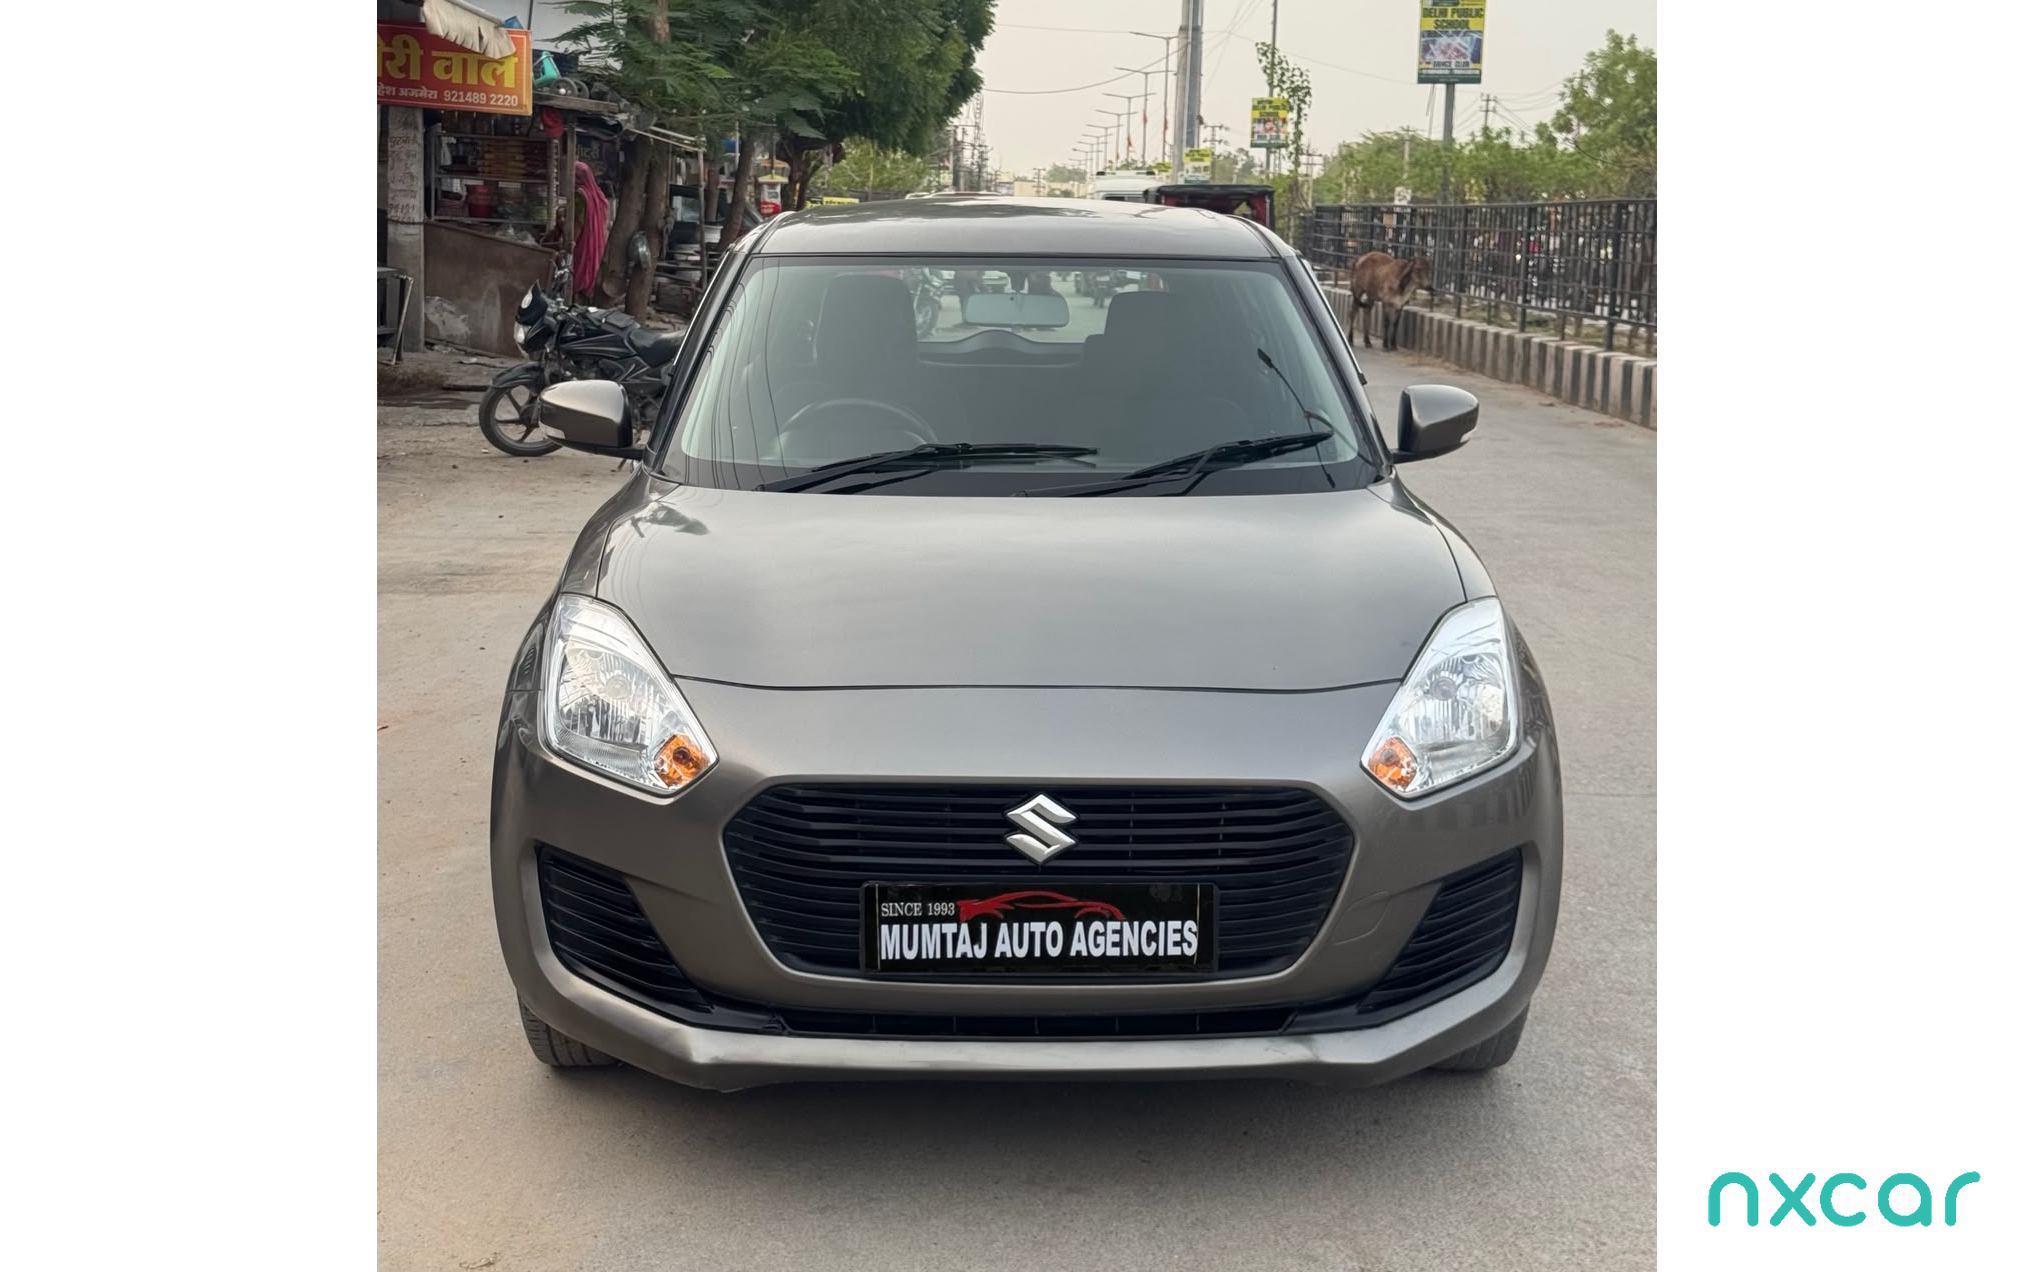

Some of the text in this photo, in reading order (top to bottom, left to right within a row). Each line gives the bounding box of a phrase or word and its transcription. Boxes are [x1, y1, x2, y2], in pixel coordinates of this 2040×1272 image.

[443, 90, 487, 104] 921489
[490, 93, 519, 107] 2220
[881, 902, 955, 917] SINCE 1993
[880, 919, 1198, 960] MUMTAJ AUTO AGENCIES
